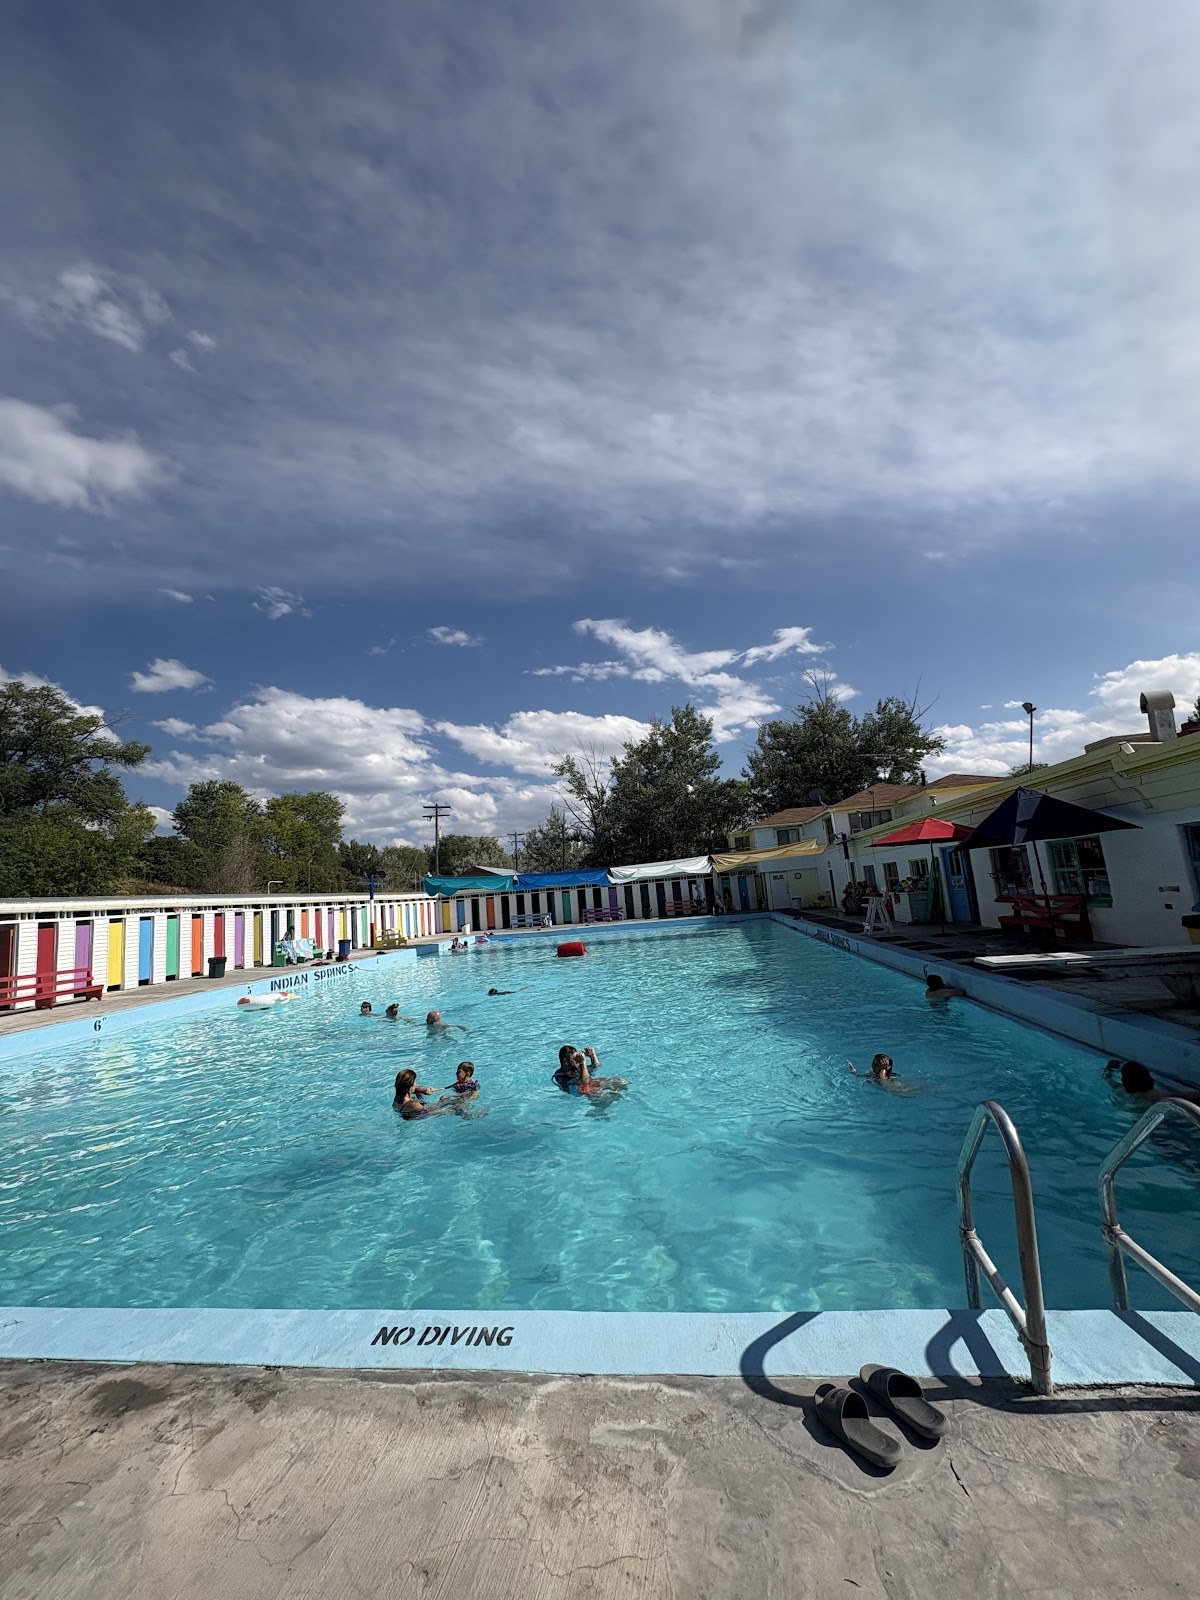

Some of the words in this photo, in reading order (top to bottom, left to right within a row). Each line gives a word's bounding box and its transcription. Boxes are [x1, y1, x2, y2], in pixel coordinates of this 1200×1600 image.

[270, 973, 308, 991] INDIAN
[313, 963, 354, 981] SPRINGS
[370, 1326, 416, 1346] NO
[416, 1326, 516, 1347] DIVING
